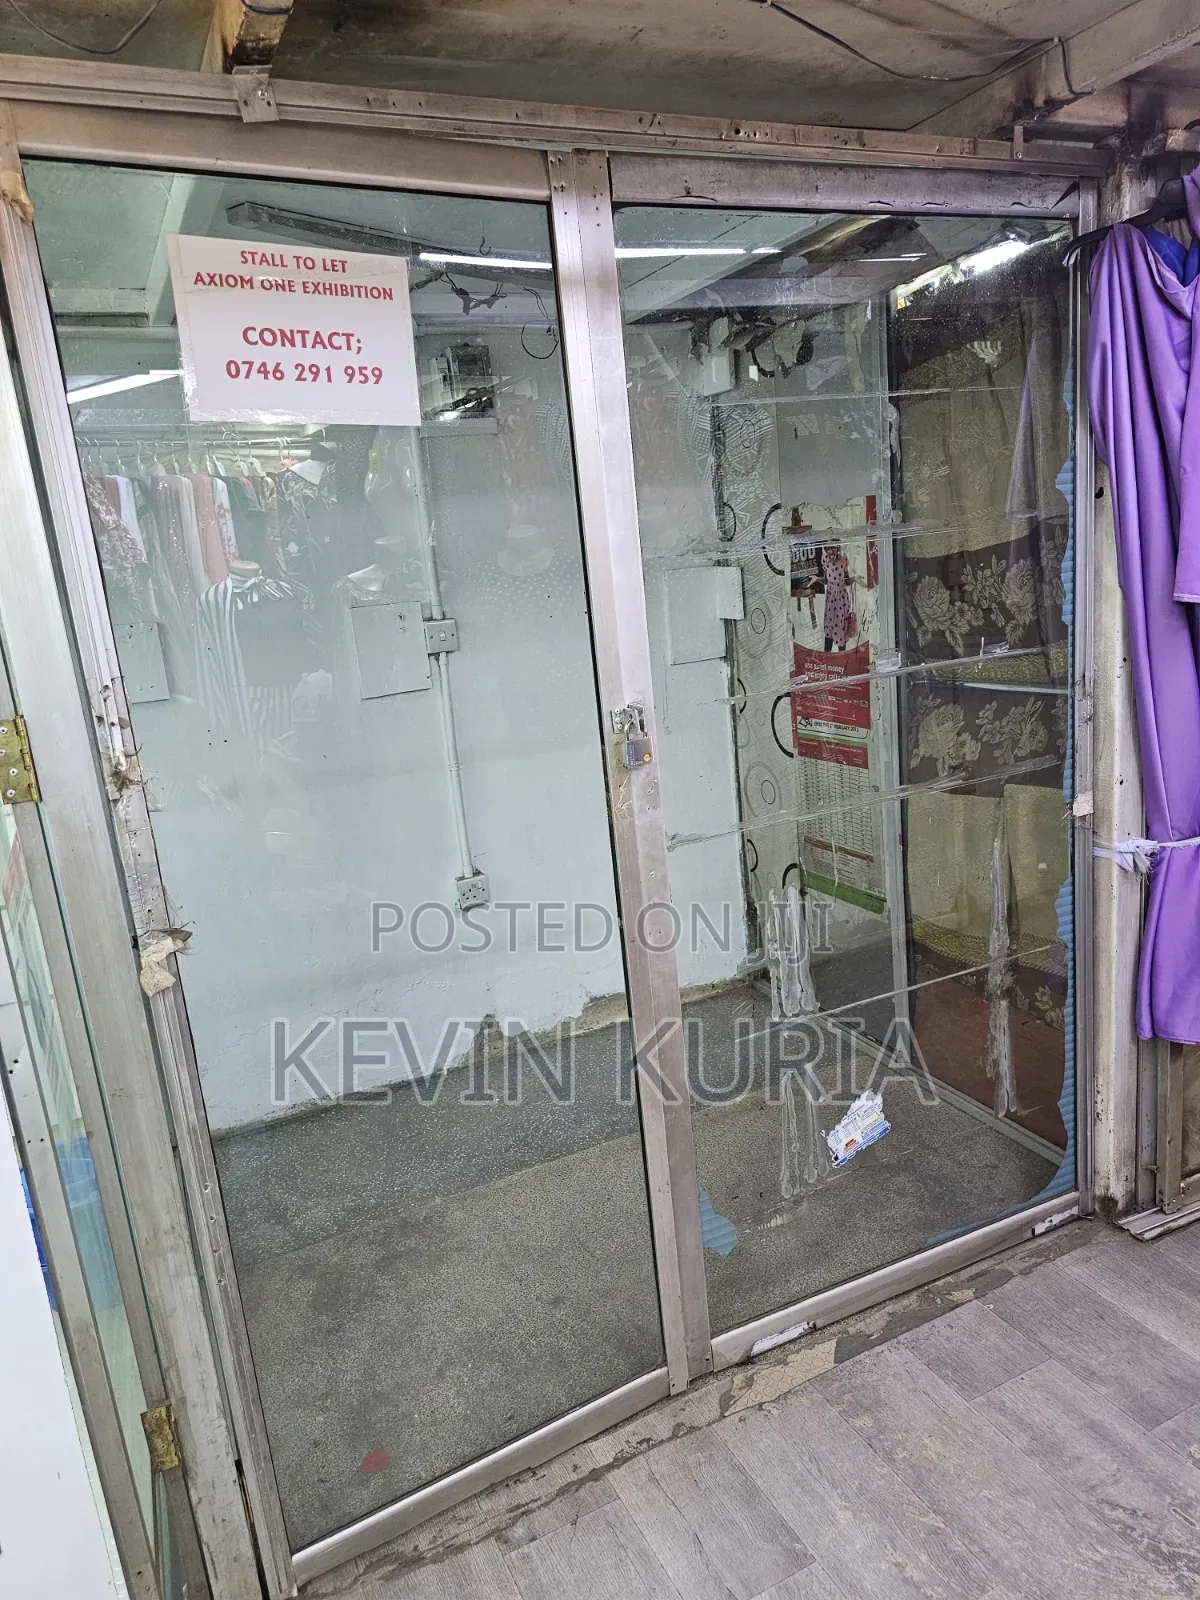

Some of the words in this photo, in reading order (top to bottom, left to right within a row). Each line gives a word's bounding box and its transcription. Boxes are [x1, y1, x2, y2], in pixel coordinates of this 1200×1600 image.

[240, 250, 289, 269] STALL
[293, 255, 317, 272] TO
[322, 257, 348, 274] LET
[193, 271, 255, 290] AXIOM
[259, 278, 297, 293] ONE
[302, 280, 394, 302] EXHIBITION
[241, 325, 363, 355] CONTACT;
[225, 359, 286, 382] 0746
[294, 362, 333, 384] 291
[343, 364, 383, 386] 959
